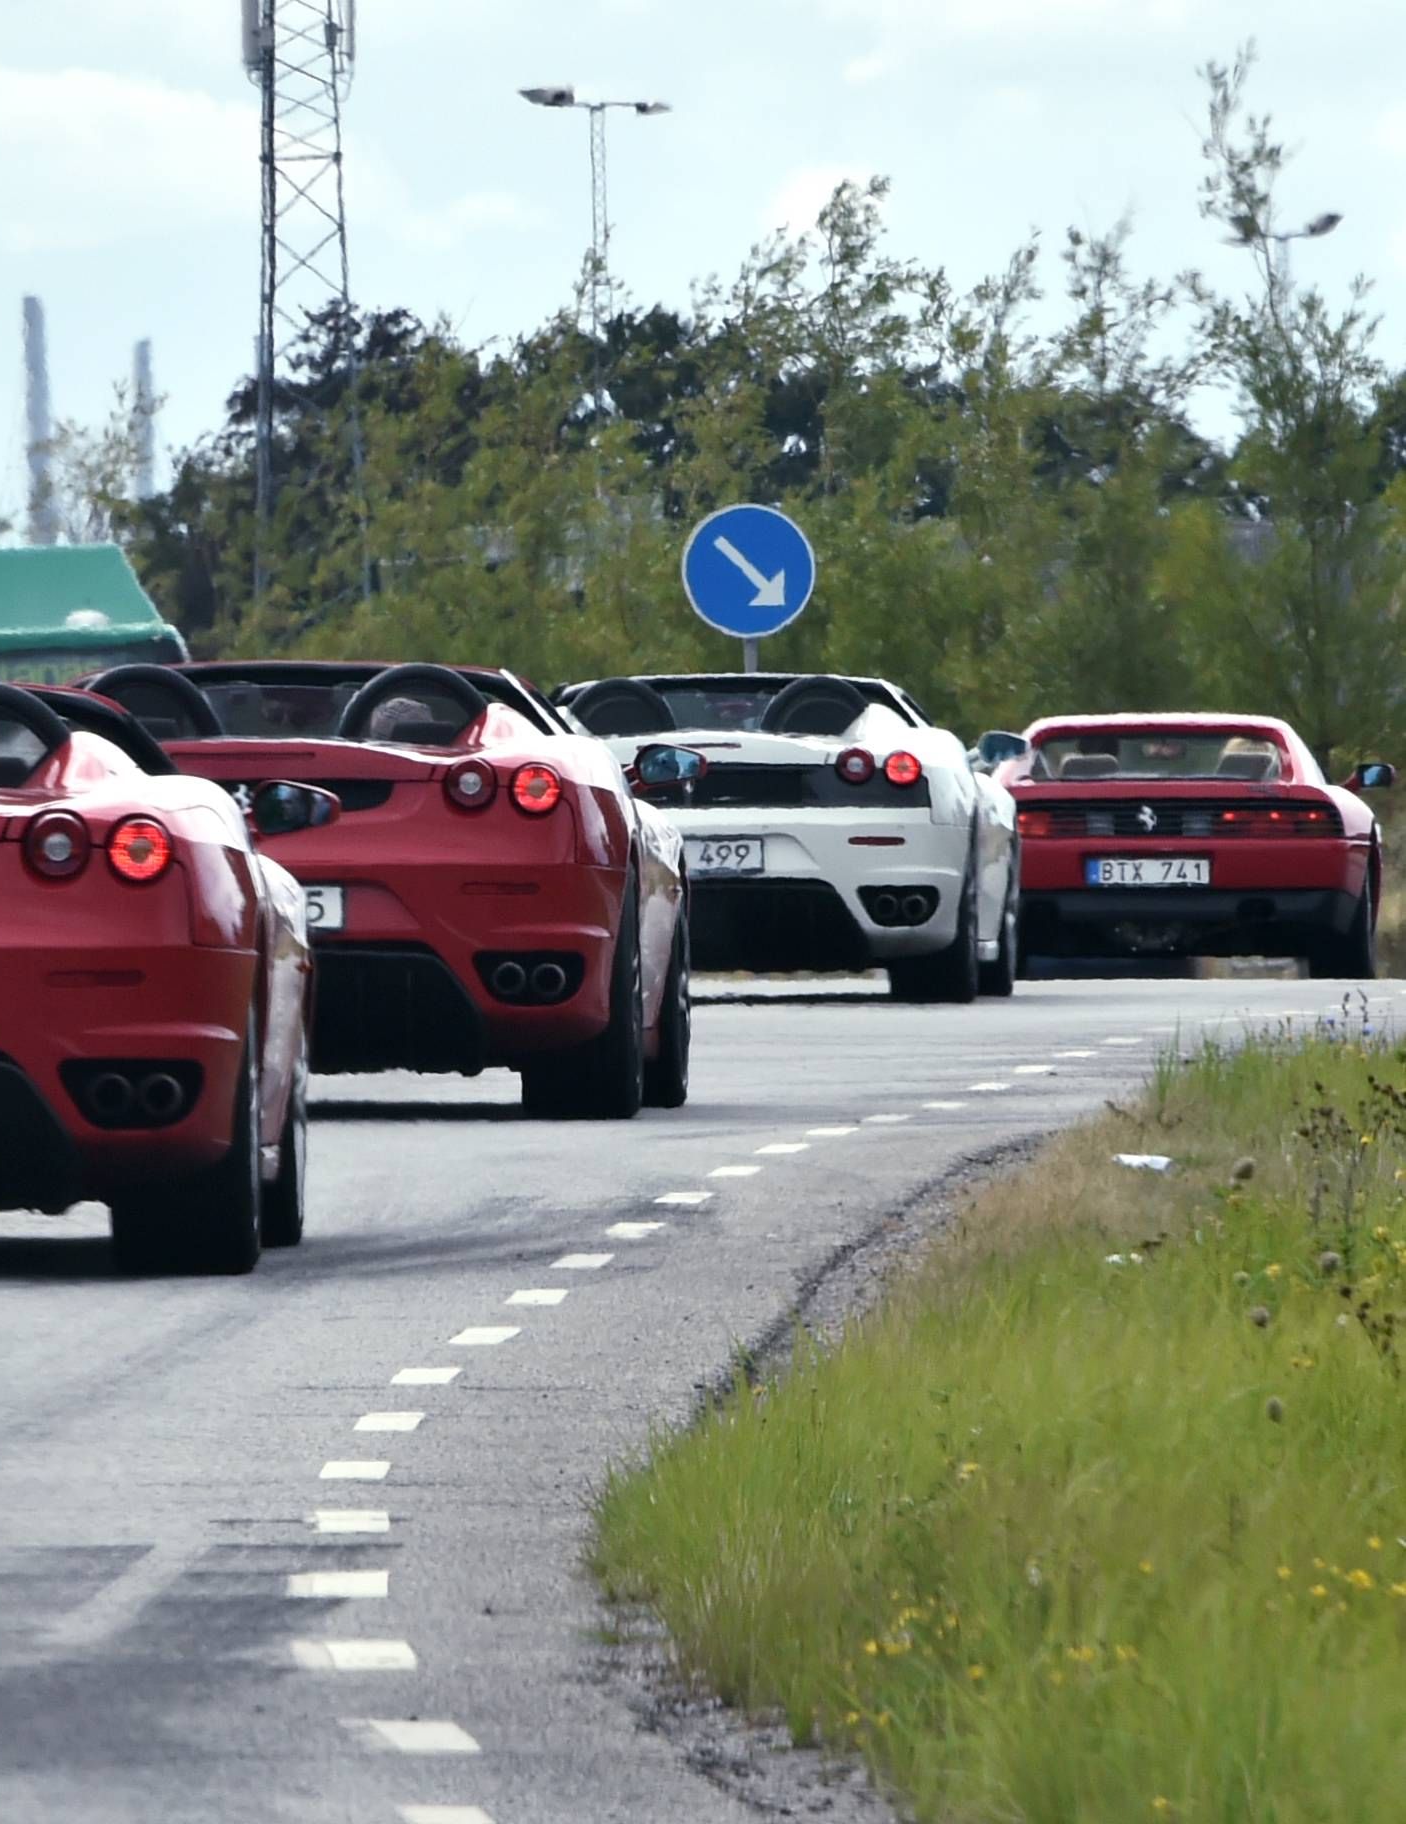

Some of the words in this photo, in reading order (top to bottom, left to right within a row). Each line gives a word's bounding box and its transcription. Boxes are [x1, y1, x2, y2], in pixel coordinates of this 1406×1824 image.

[698, 843, 750, 866] 499
[1101, 861, 1143, 882] BTX
[1161, 861, 1202, 882] 741
